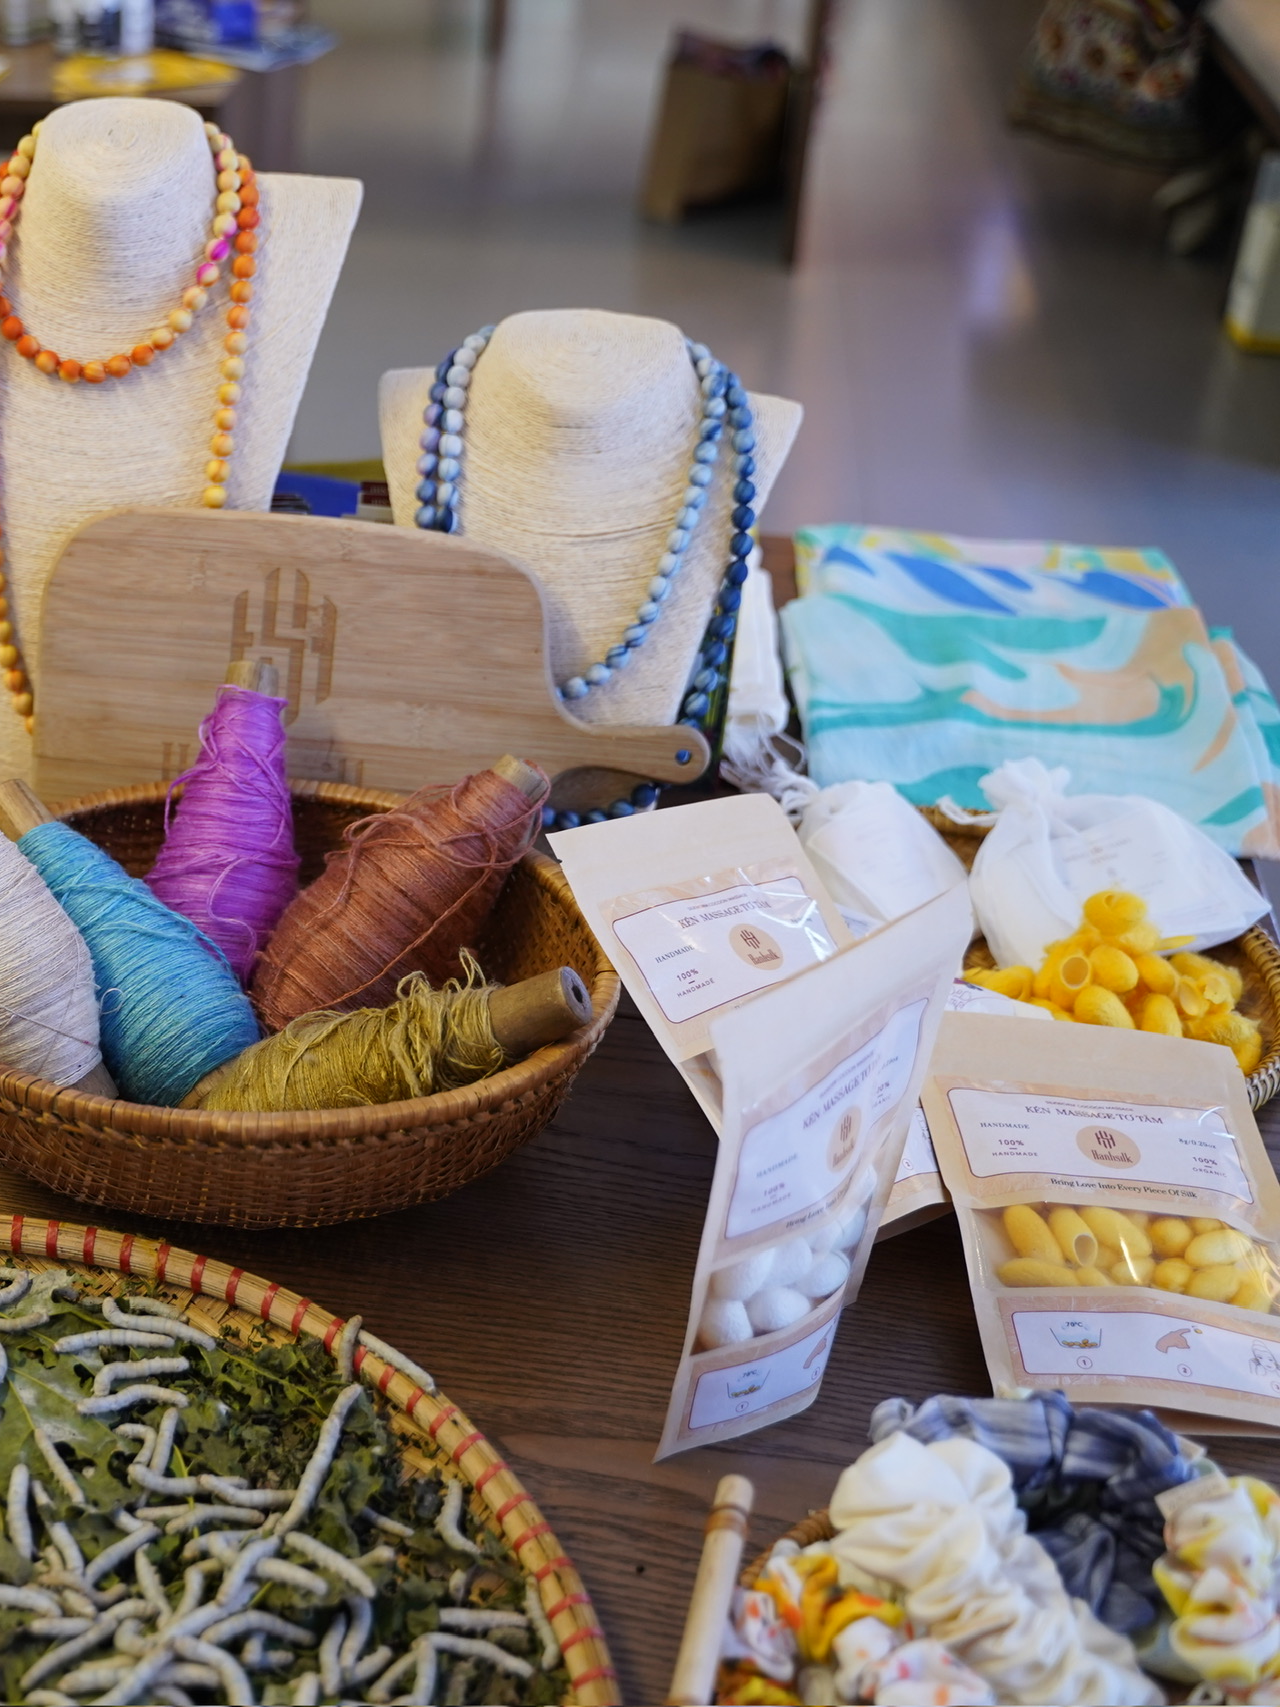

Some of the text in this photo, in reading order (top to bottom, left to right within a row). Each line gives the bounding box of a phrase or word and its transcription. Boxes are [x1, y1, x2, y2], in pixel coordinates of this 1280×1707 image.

[700, 905, 741, 922] MASSAGE
[655, 945, 695, 964] HANDMADE
[676, 968, 699, 982] 100%
[677, 978, 715, 998] HANDMADE
[1055, 1108, 1116, 1120] MASSAGE
[980, 1122, 1030, 1130] HANDMADE
[998, 1138, 1024, 1146] 100%
[1091, 1149, 1133, 1163] Hanhsilk
[1192, 1156, 1218, 1166] 100%
[1192, 1167, 1228, 1178] ORGANIC
[1050, 1177, 1198, 1198] Bring Love Into Every Piece Of Silk
